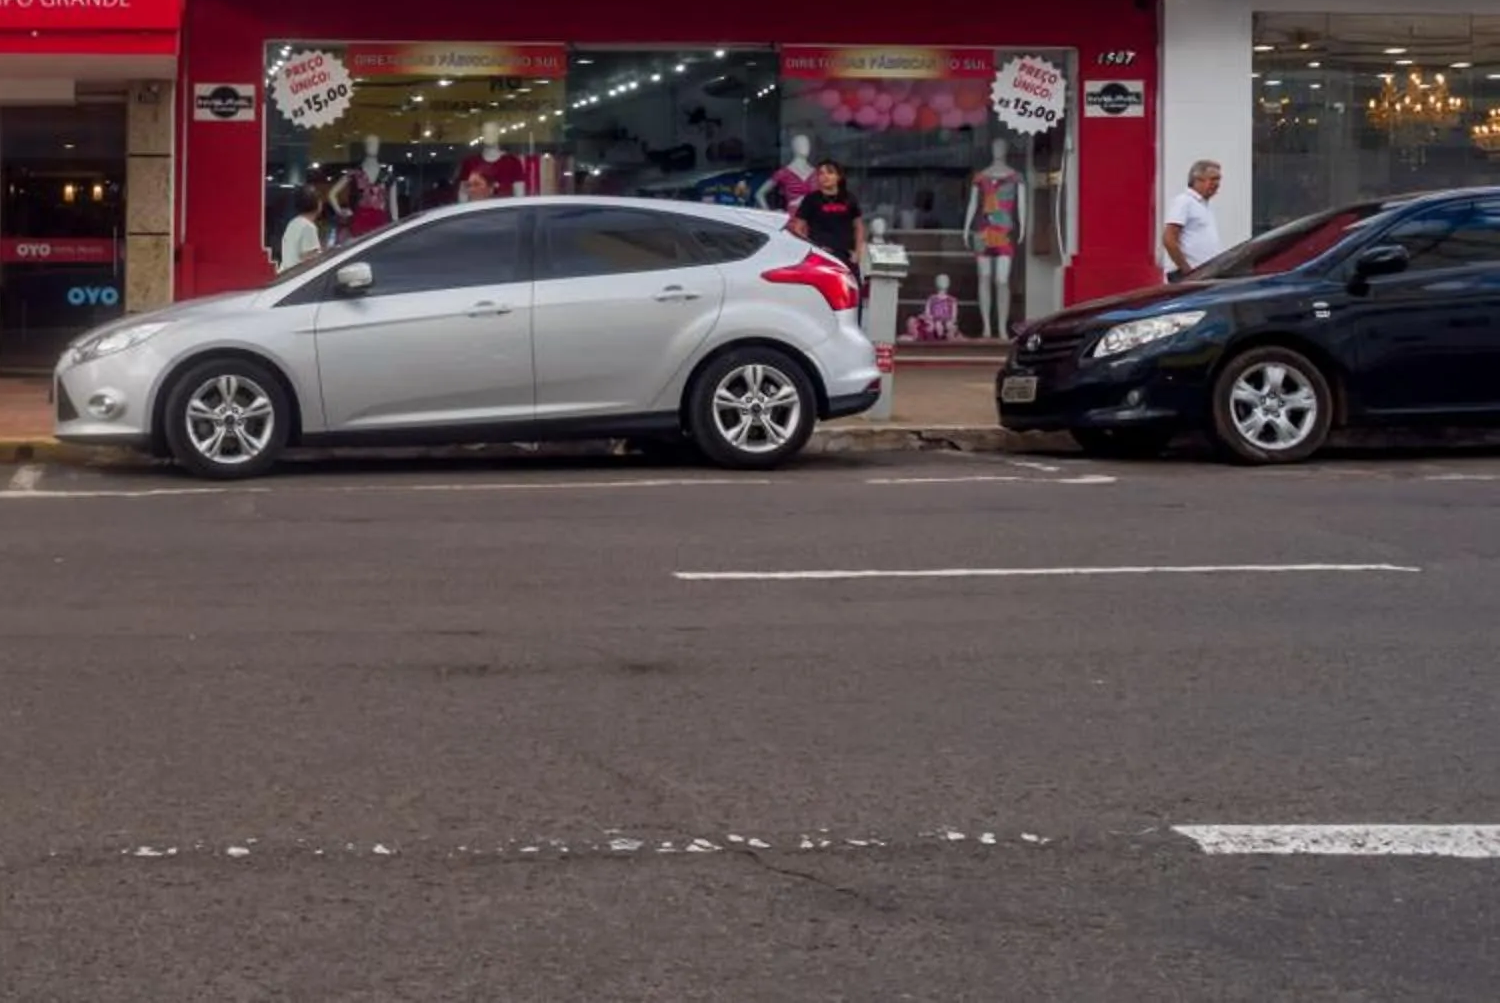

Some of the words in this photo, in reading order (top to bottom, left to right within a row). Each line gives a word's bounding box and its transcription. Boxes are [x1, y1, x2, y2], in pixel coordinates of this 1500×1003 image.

[1019, 62, 1058, 85] PREÇO
[304, 83, 348, 113] 15,00
[1013, 97, 1056, 122] 15,00
[16, 243, 51, 257] OYO
[67, 286, 119, 306] OYO
